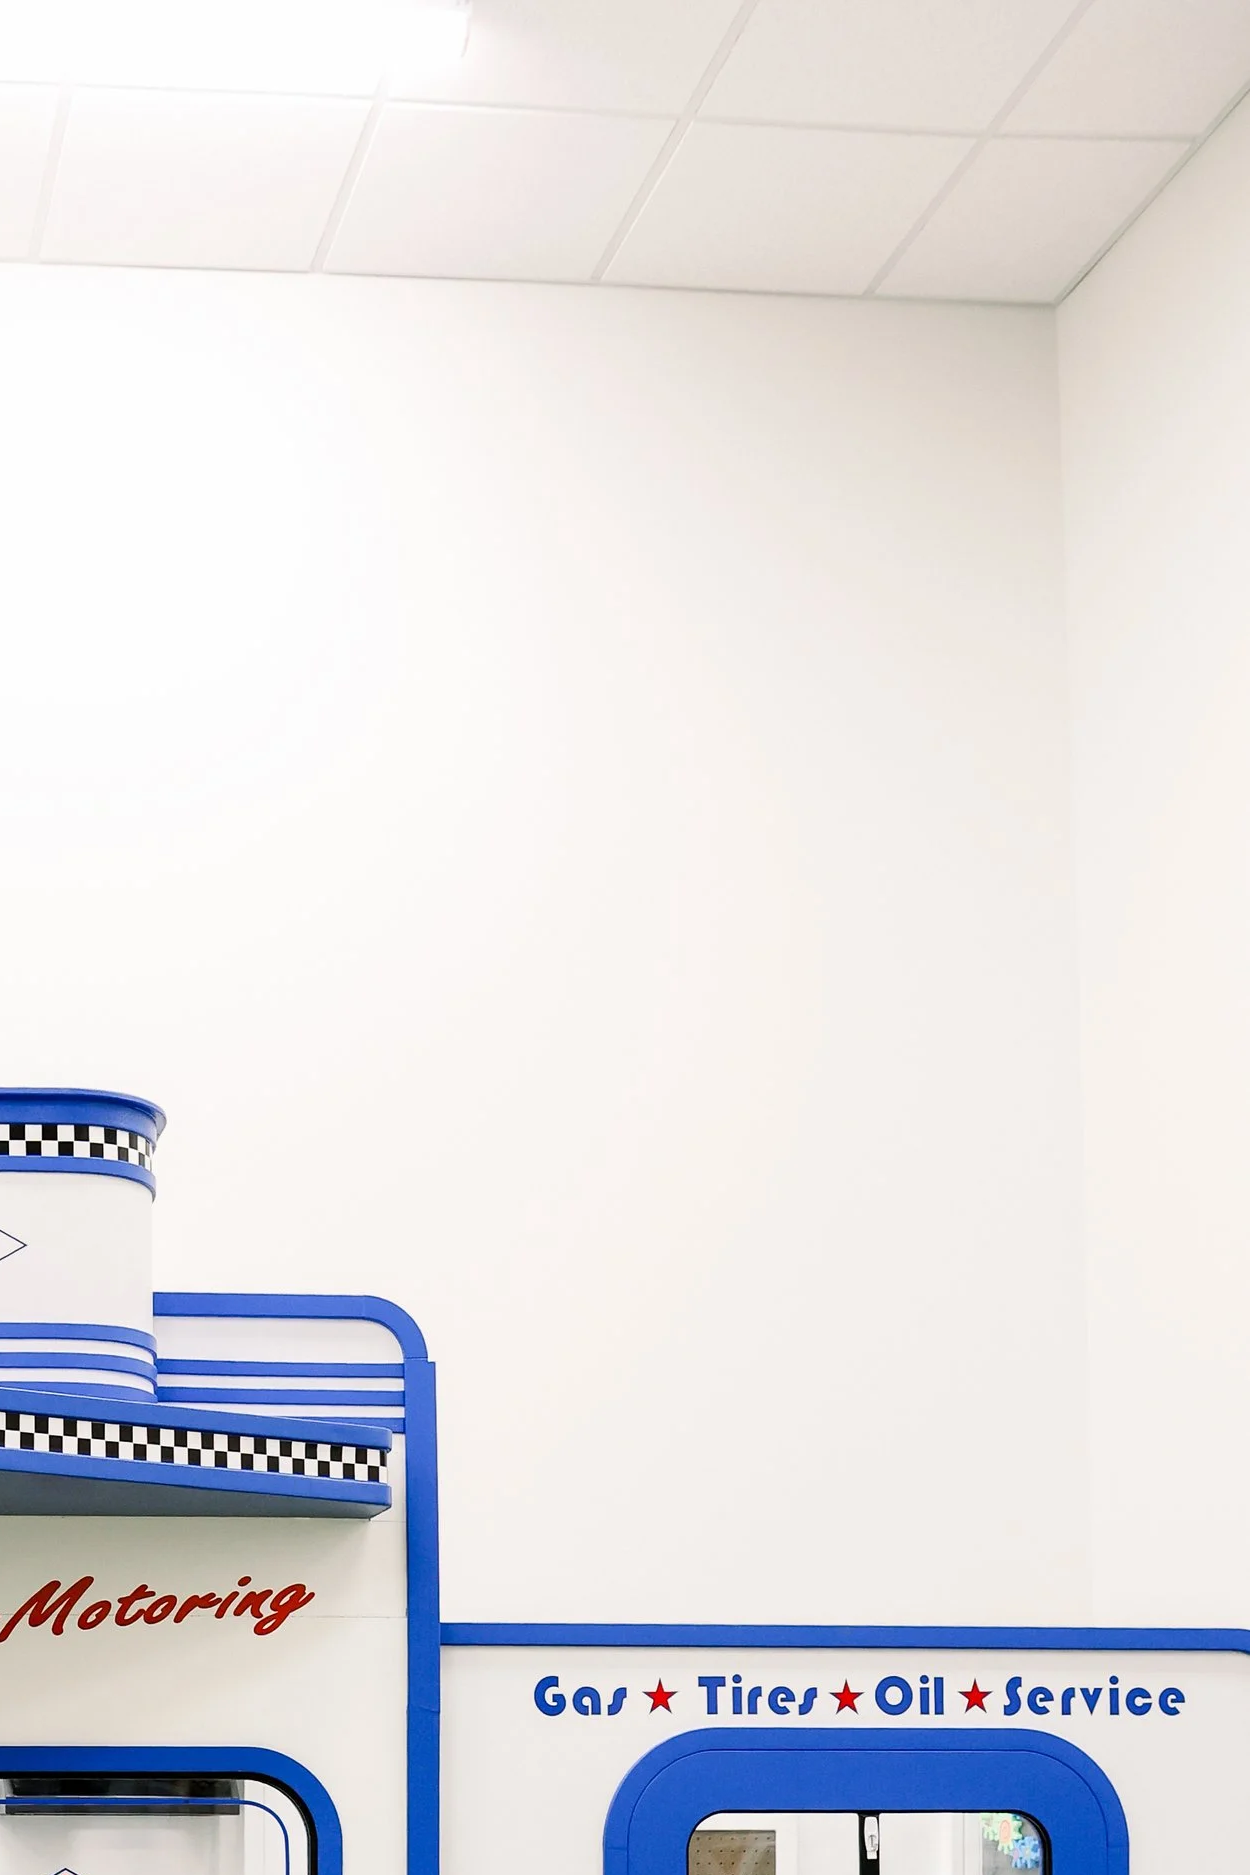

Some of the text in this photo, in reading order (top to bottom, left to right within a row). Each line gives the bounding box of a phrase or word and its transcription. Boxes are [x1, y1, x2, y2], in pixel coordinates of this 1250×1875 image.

[534, 1675, 1185, 1717] Gas Tires Oil Service
